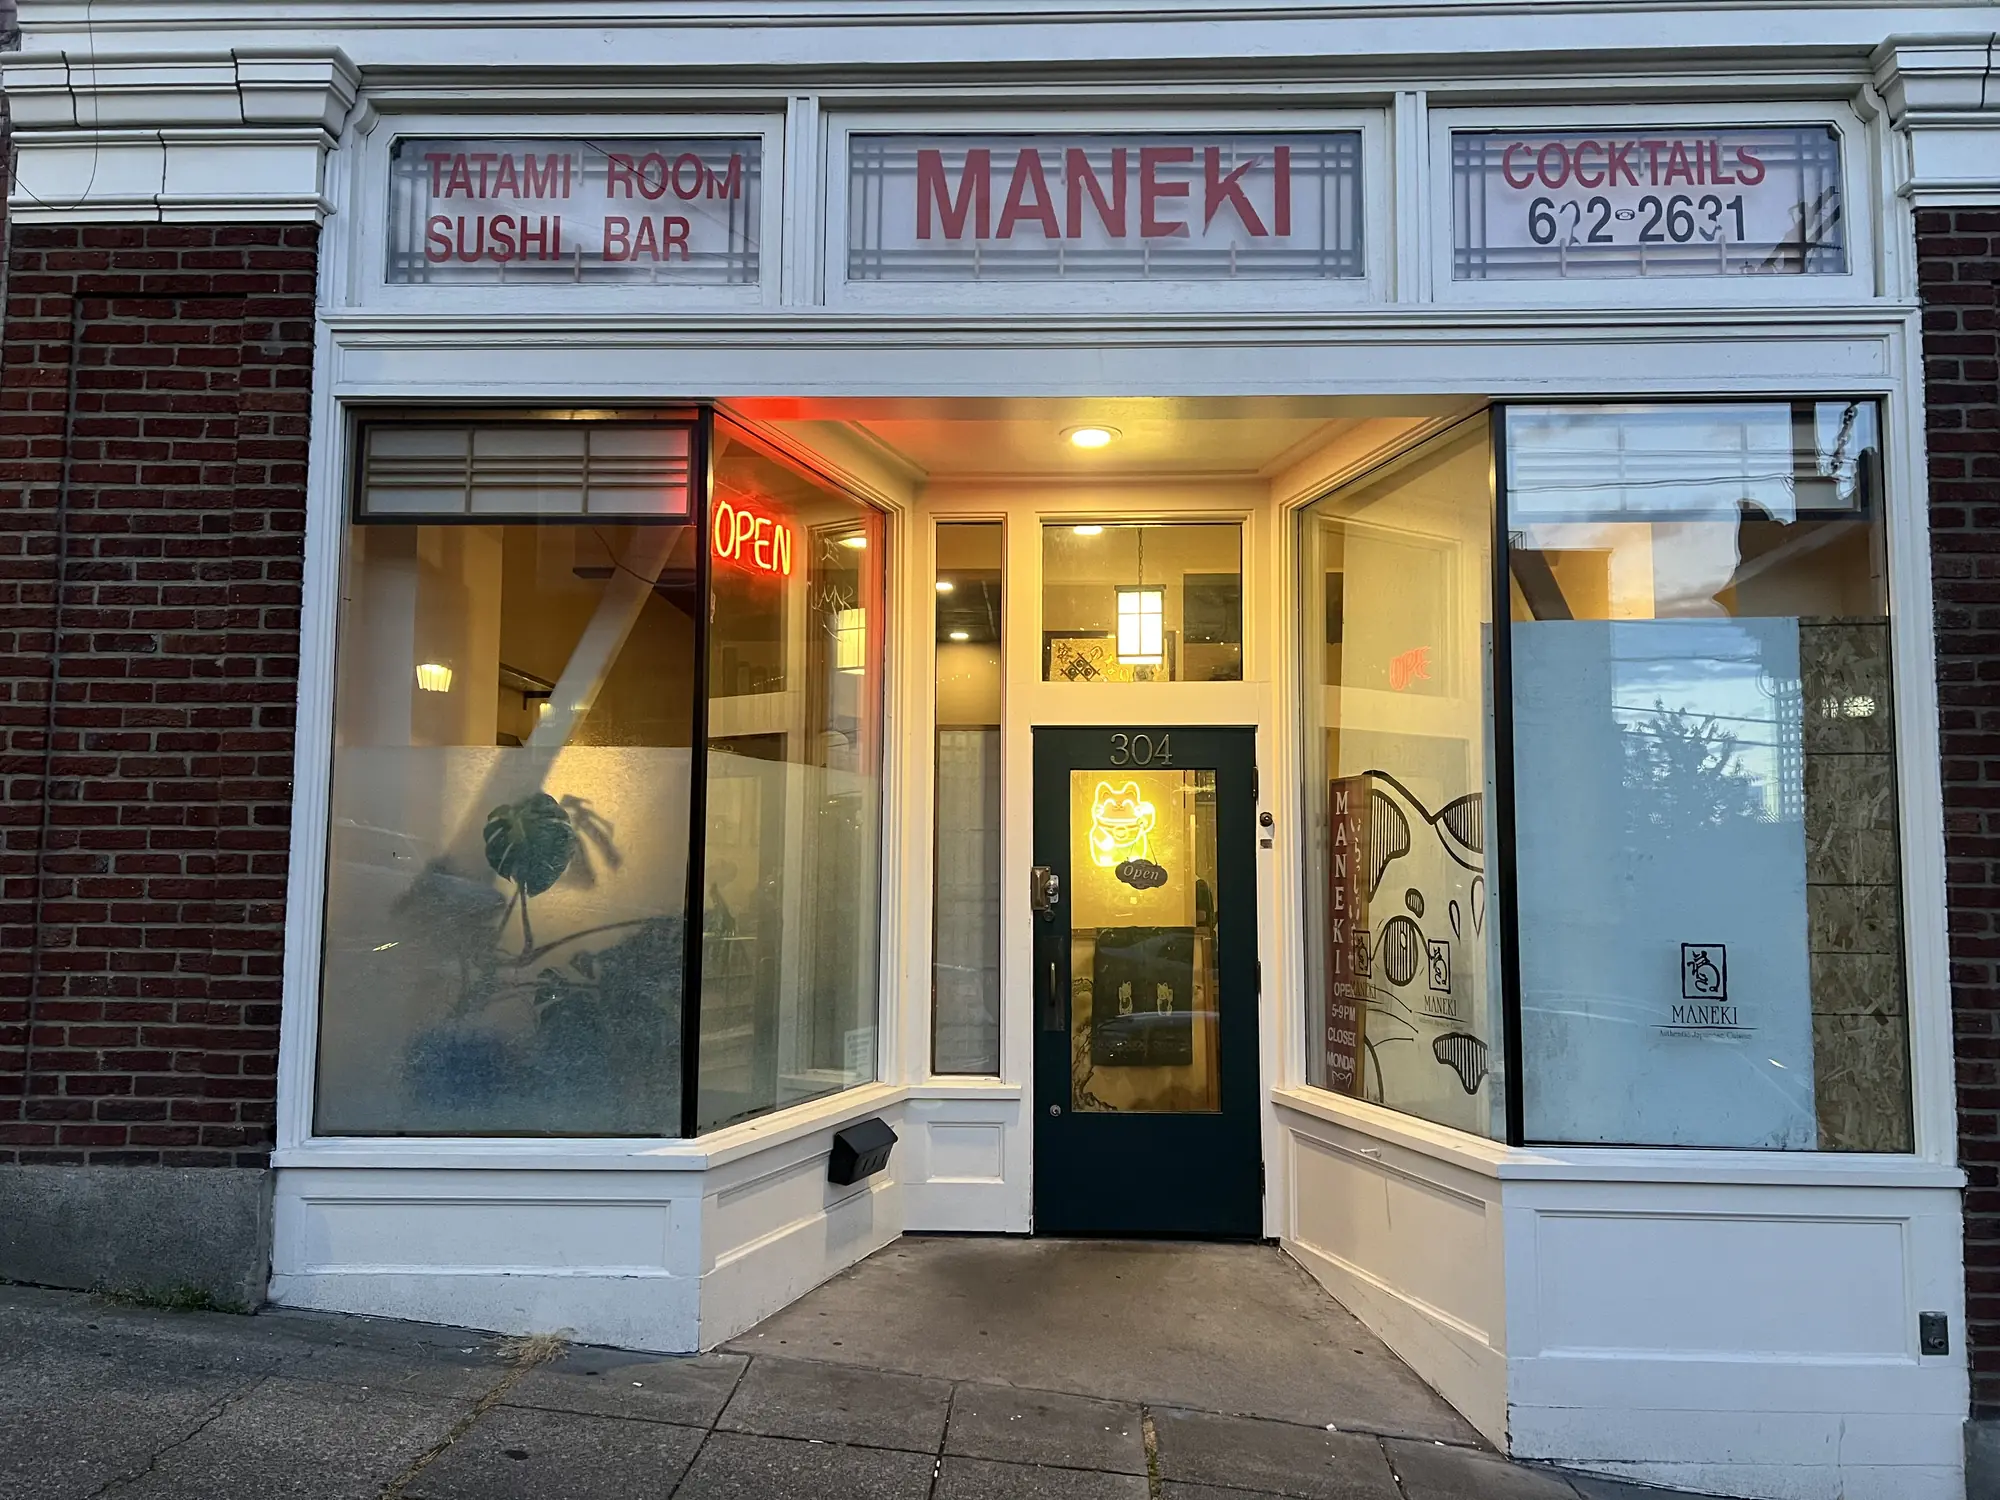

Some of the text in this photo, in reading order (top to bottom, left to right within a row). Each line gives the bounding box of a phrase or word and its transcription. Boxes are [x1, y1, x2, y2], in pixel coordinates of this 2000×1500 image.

[424, 152, 741, 200] TATAMI ROOM
[1502, 140, 1766, 190] COCKTAILS
[916, 145, 1290, 240] MANEKI
[424, 214, 691, 263] SUSHI BAR
[714, 500, 792, 576] OPEN
[1109, 733, 1173, 766] 304
[1123, 865, 1159, 880] Open
[1332, 790, 1350, 974] MANEKI
[1424, 995, 1457, 1016] MANEKI
[1671, 1004, 1739, 1025] MANEKI
